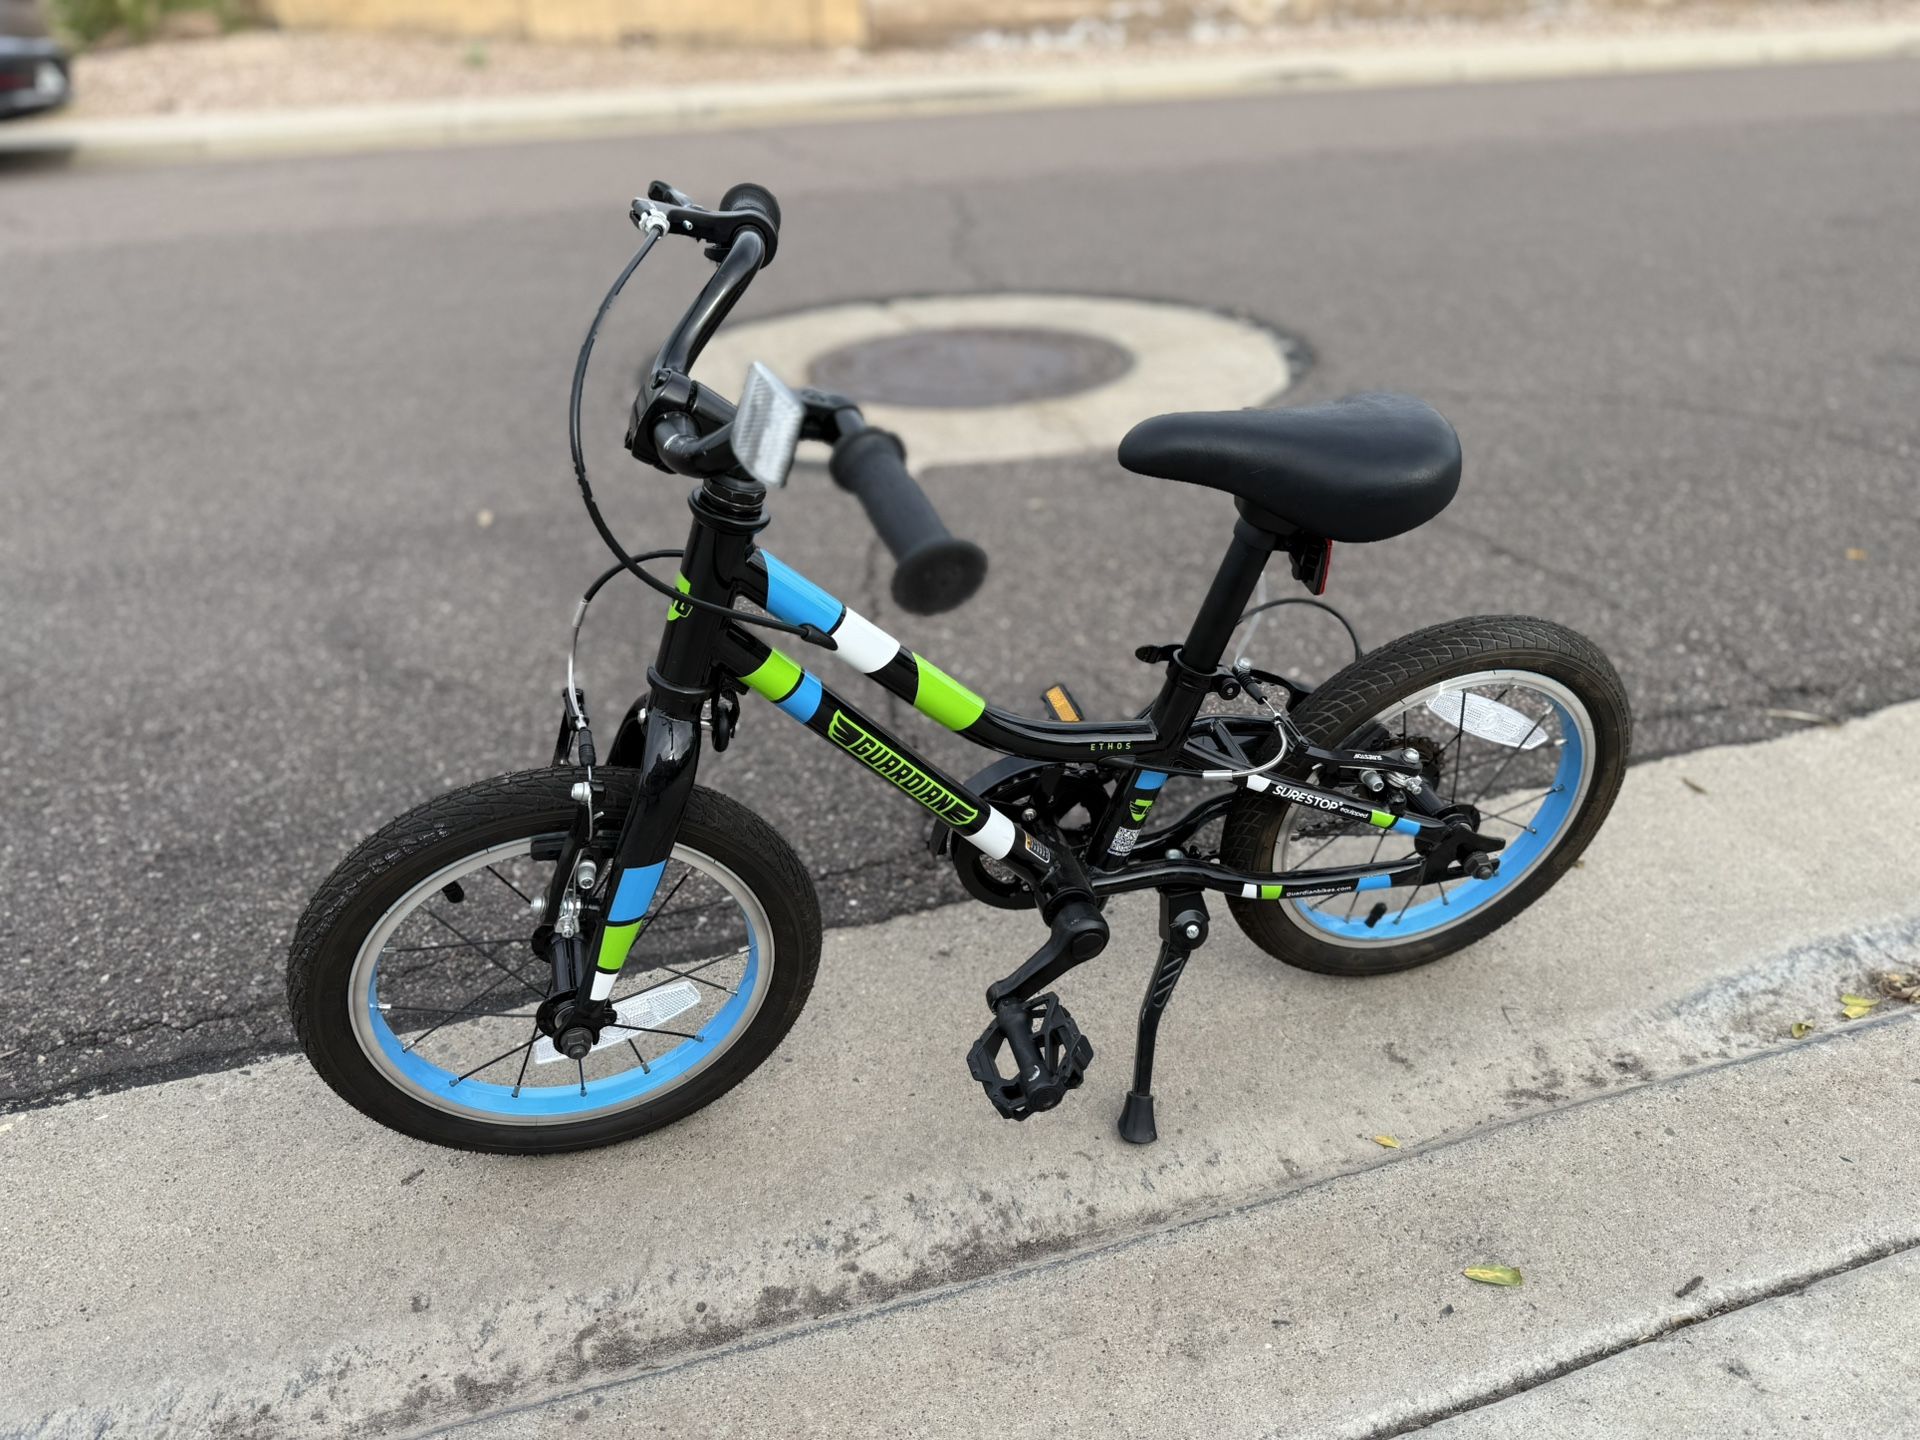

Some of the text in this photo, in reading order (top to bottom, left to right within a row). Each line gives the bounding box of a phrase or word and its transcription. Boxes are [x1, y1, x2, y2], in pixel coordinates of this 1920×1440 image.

[1090, 742, 1132, 751] ETHOS
[856, 736, 957, 812] GUARDIAN
[1340, 806, 1369, 819] equipped
[1286, 886, 1352, 897] guardianbikes.com
